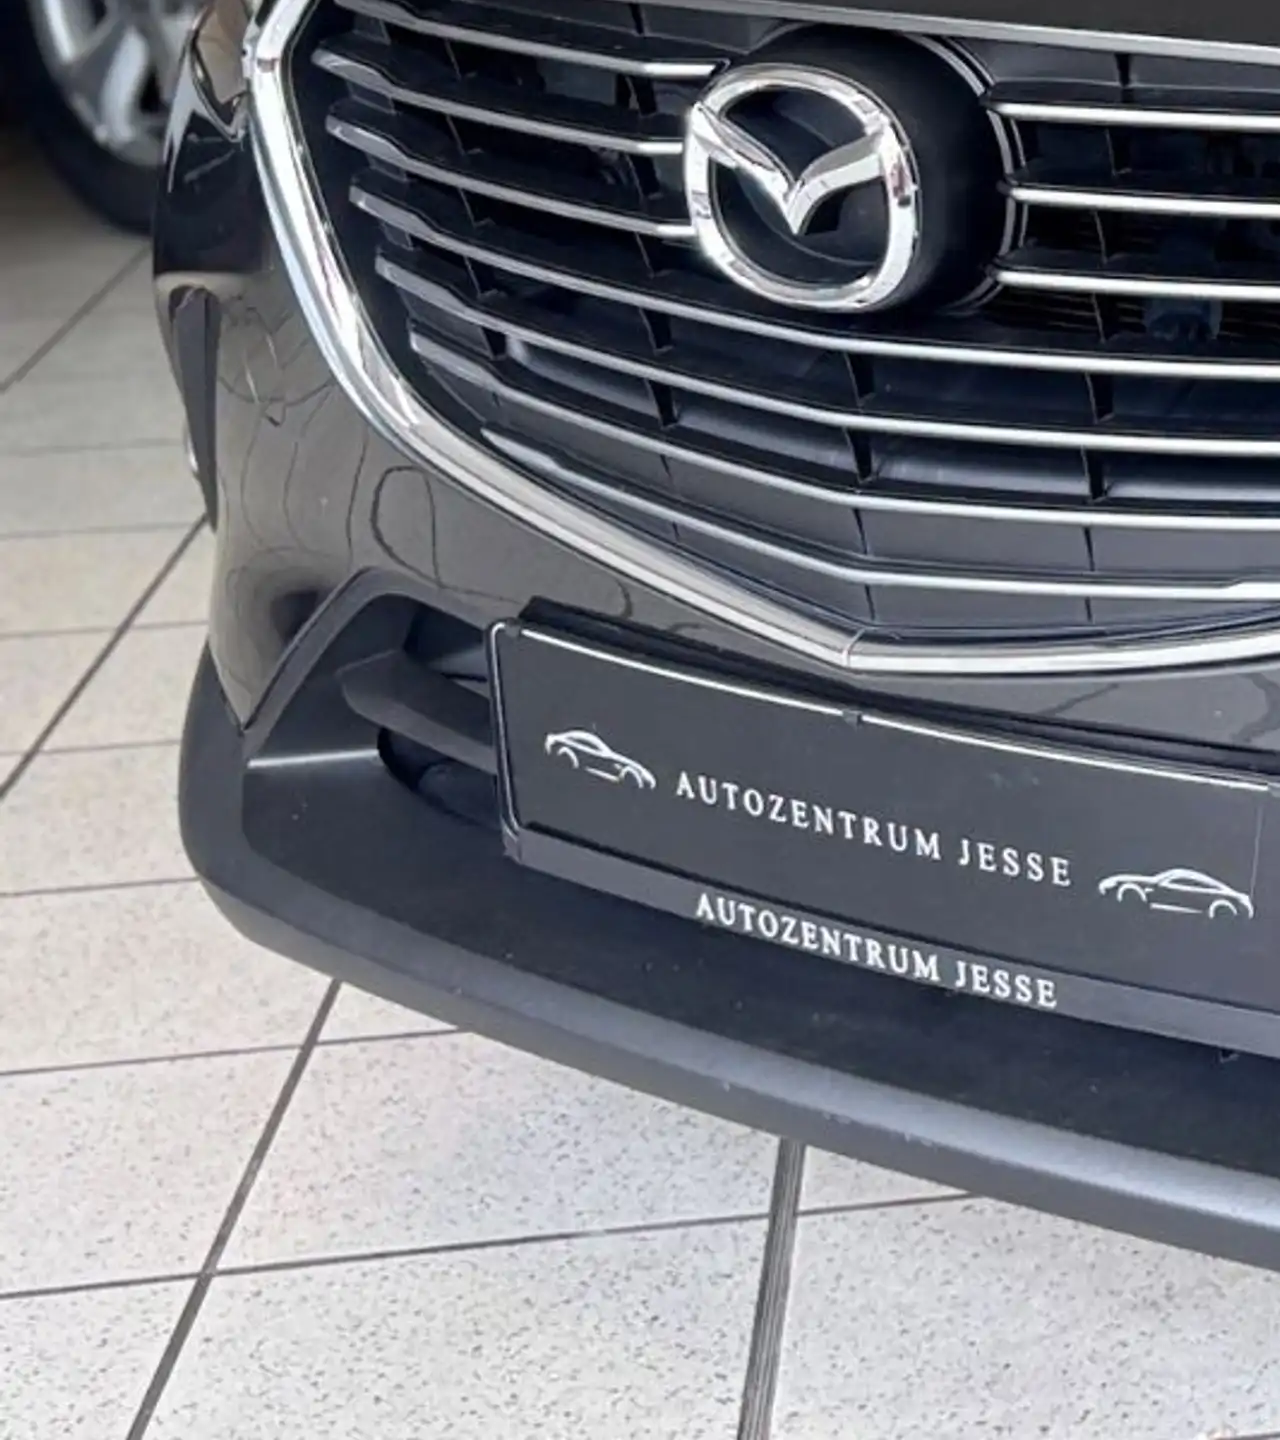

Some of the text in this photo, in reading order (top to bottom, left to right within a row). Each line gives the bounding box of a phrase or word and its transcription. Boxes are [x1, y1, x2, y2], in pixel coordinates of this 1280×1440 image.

[675, 771, 1071, 887] AUTOZENTRUM JESSE
[696, 893, 1057, 1008] AUTOZENTRUM JESSE
